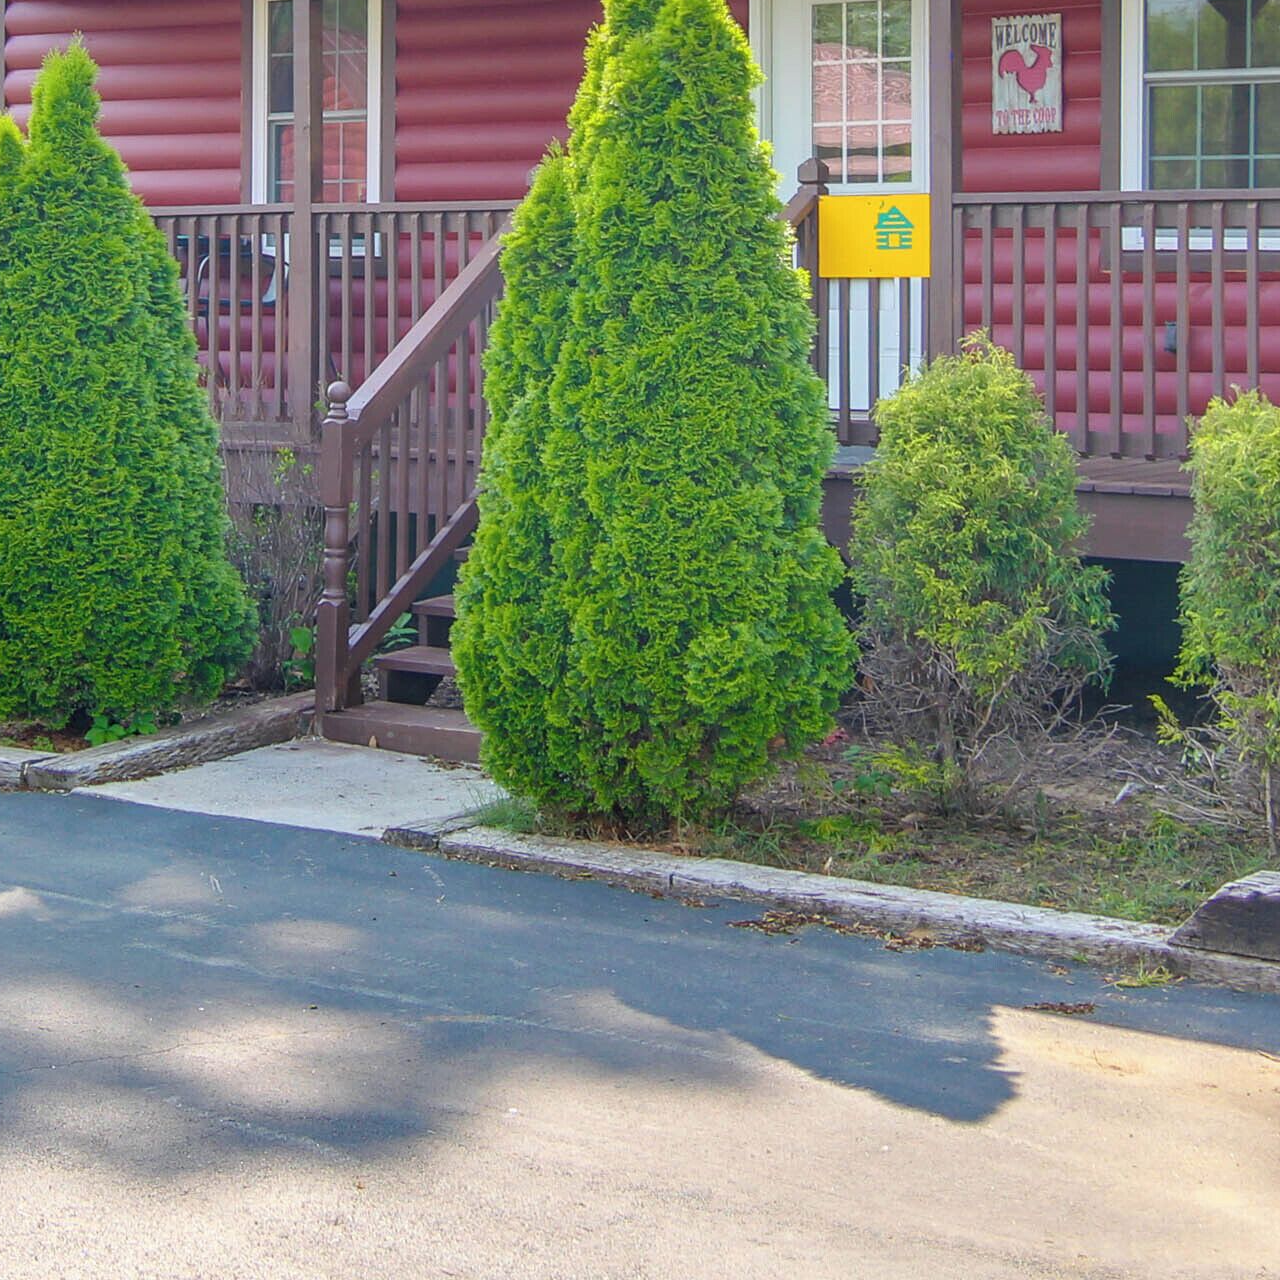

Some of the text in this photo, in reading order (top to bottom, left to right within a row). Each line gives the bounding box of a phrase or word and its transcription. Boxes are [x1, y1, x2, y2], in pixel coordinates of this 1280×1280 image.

[994, 22, 1057, 51] WELCOME
[995, 107, 1057, 127] TO THE COOP
